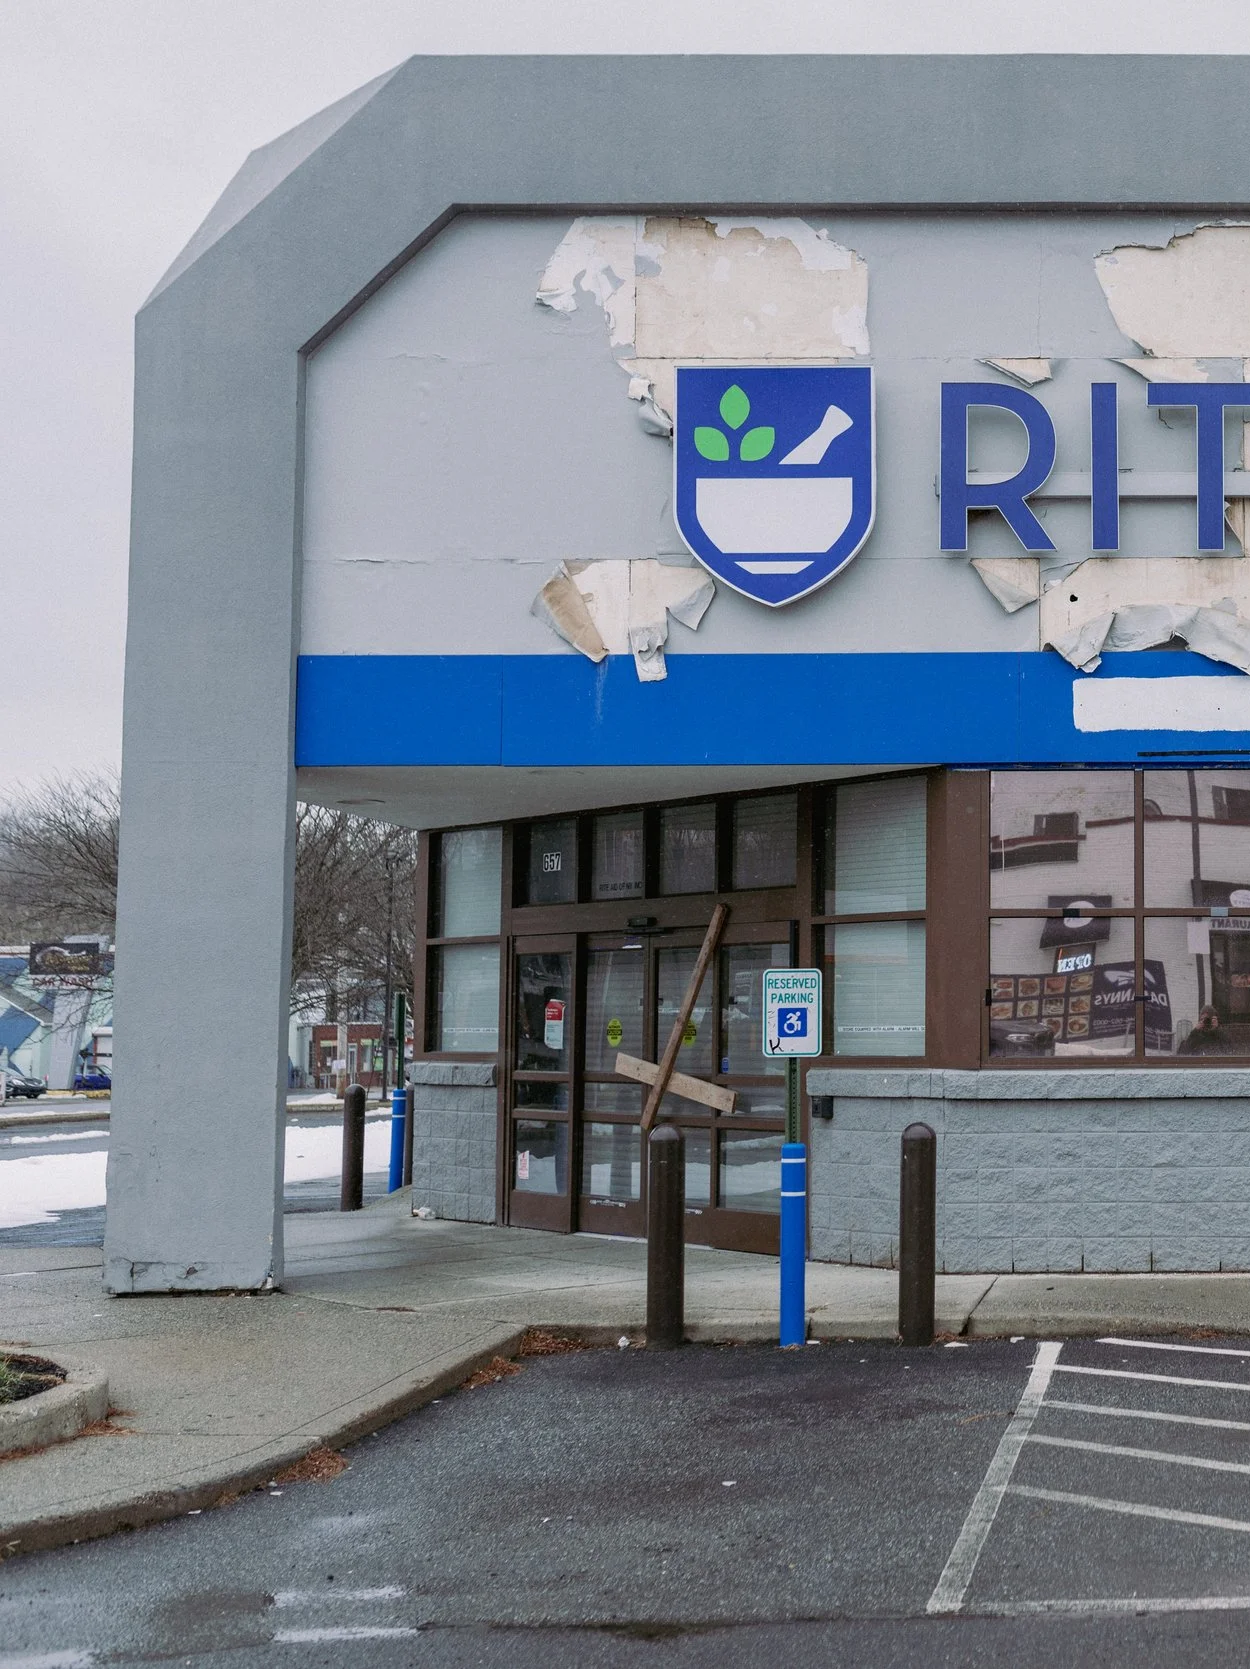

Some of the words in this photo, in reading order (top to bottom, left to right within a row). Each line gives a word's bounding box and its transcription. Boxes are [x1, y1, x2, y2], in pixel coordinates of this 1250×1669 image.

[544, 853, 561, 871] 657
[768, 978, 817, 989] RESERVED
[771, 993, 814, 1004] PARKING
